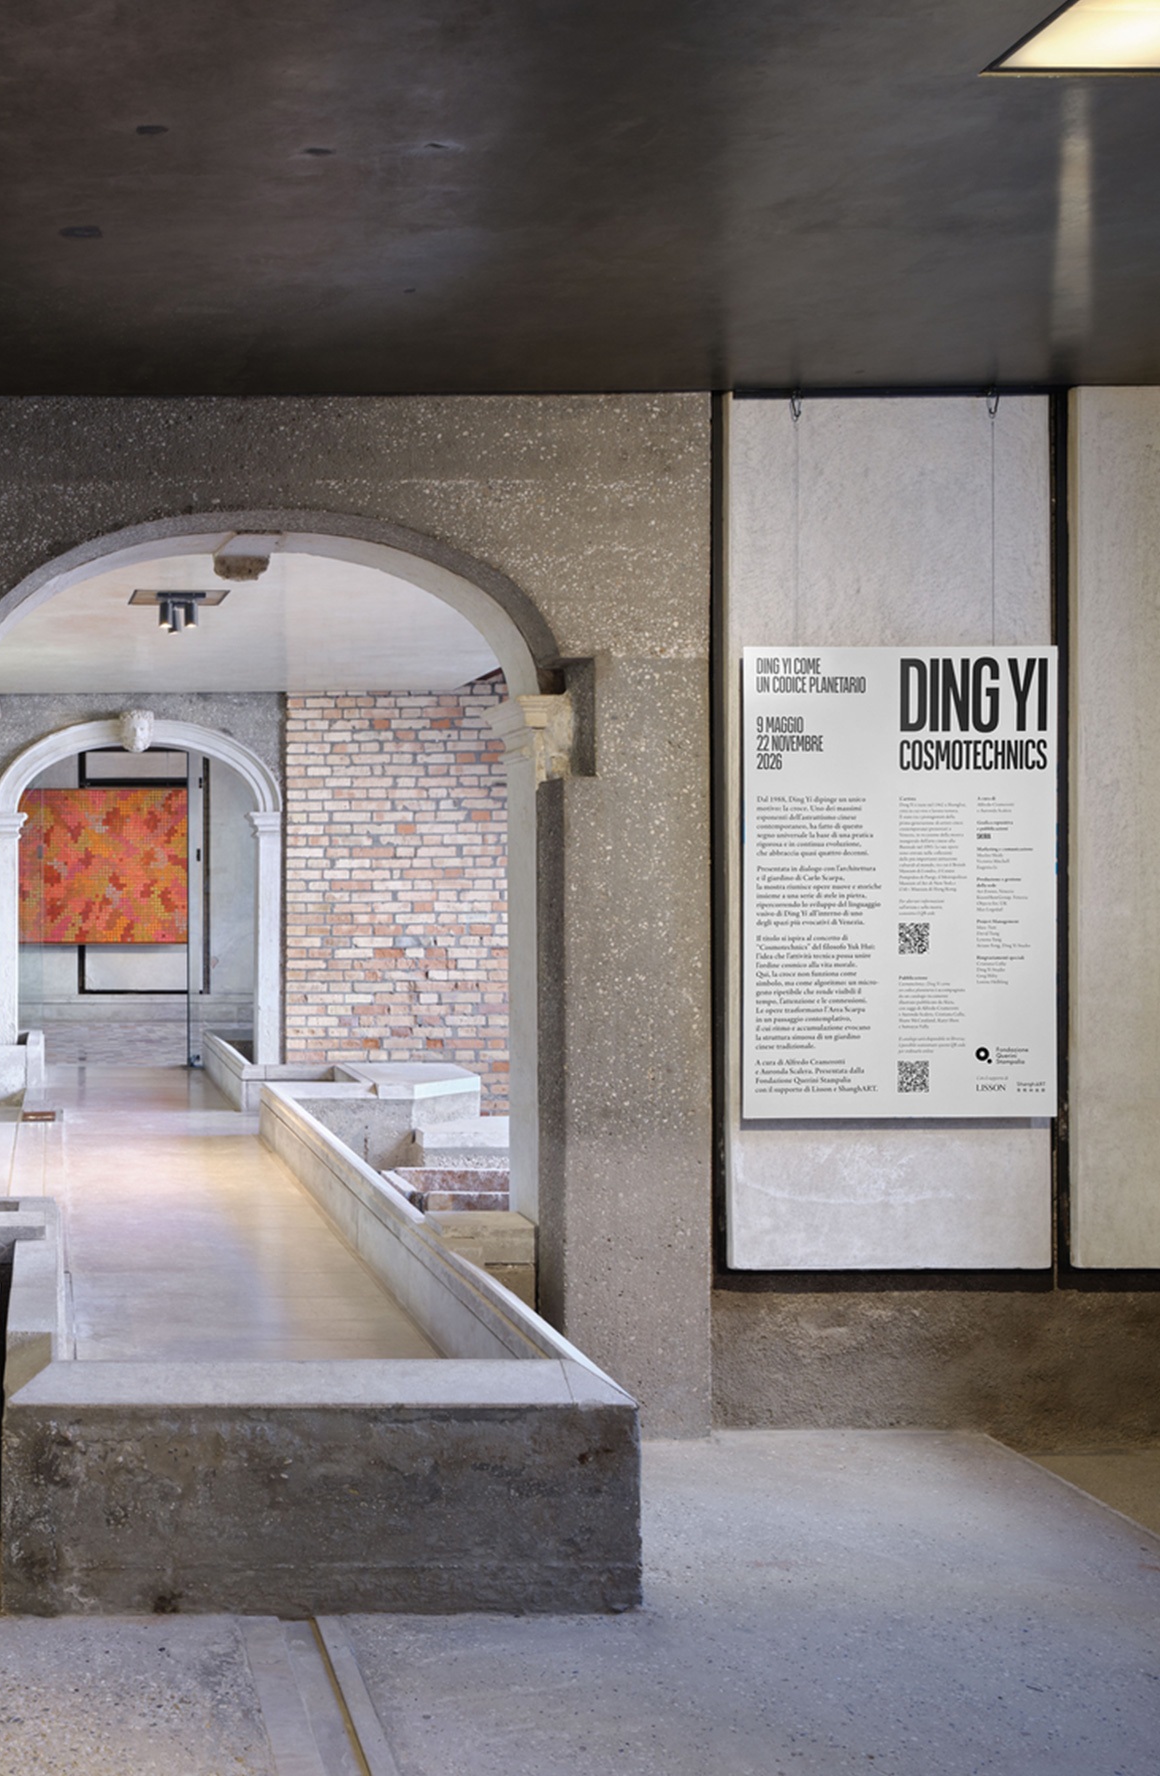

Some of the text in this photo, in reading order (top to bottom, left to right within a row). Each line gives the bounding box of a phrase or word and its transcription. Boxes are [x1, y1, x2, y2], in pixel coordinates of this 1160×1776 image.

[756, 657, 821, 674] DING YI COME
[756, 676, 866, 693] UN CODICE PLANETARIO
[900, 657, 1048, 733] DING YI
[756, 716, 804, 733] 9 MAGGIO
[756, 735, 824, 751] 22 NOVEMBRE
[756, 753, 782, 770] 2026
[900, 739, 1048, 771] COSMOTECHNICS
[976, 1084, 1006, 1092] LISSON
